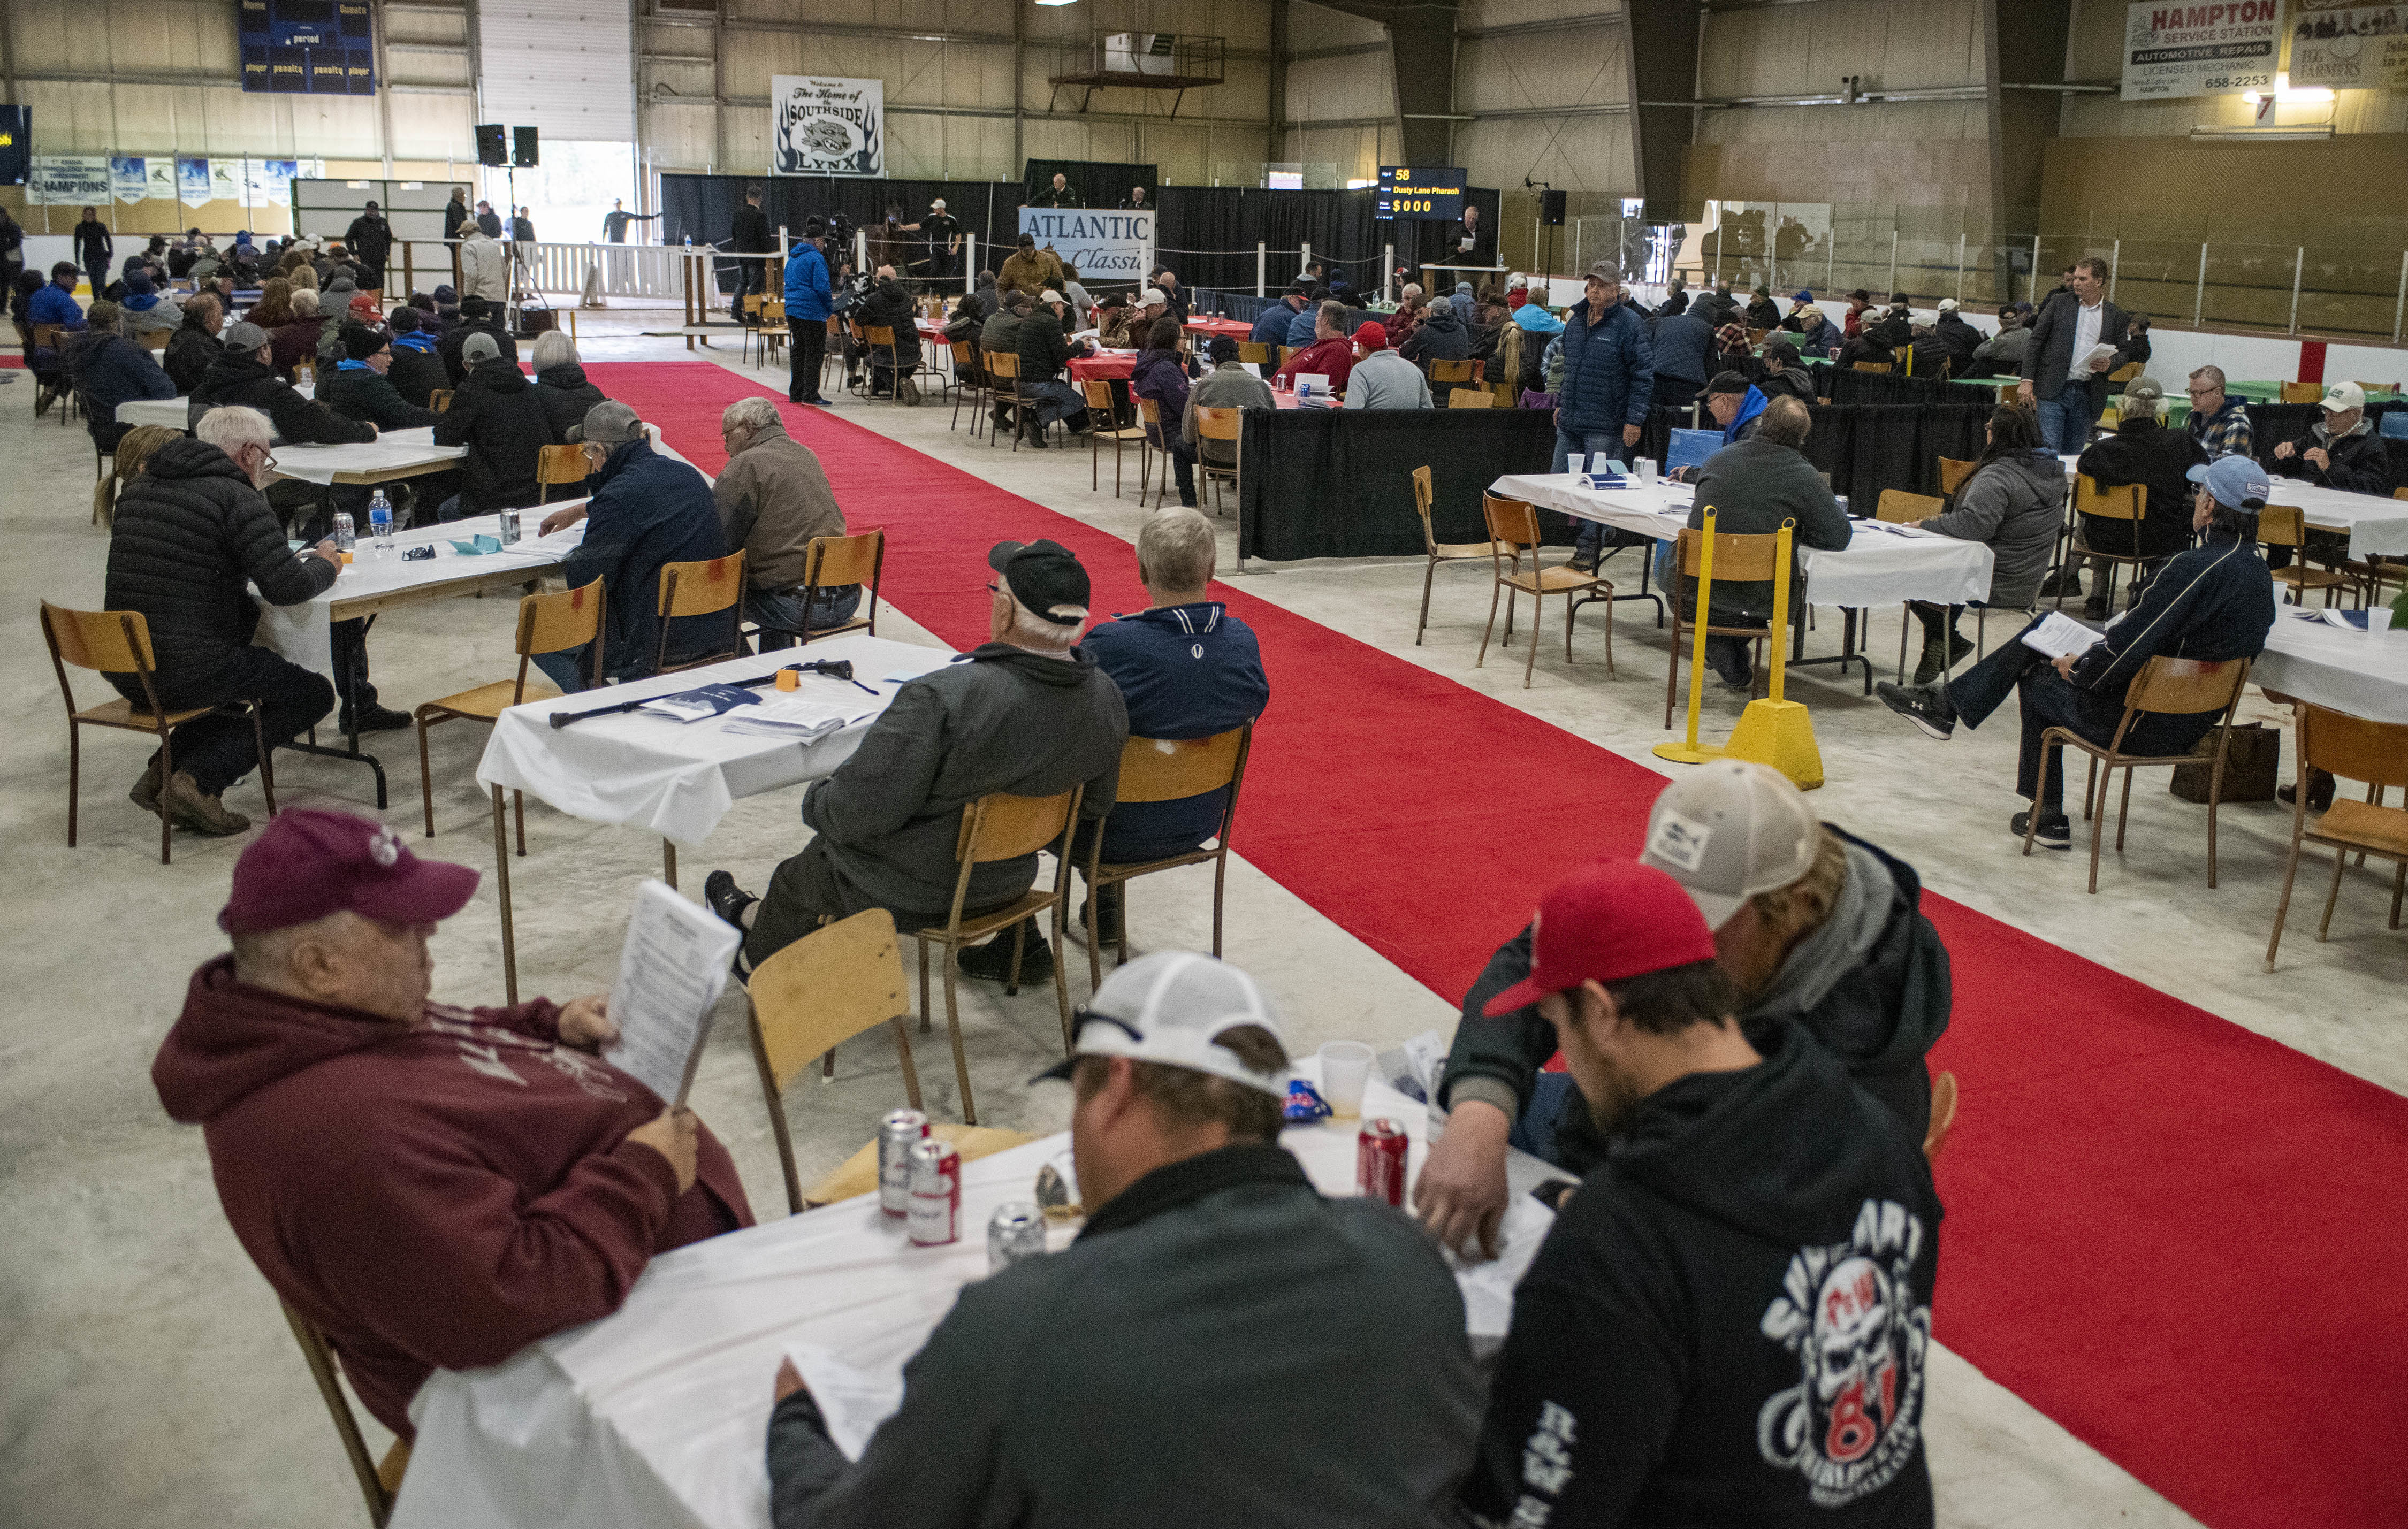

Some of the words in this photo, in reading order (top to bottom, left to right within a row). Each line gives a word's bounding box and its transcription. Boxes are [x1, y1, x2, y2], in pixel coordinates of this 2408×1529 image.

[2152, 0, 2276, 30] HAMPTON
[294, 34, 320, 43] period
[2163, 29, 2217, 44] SERVICE
[2220, 25, 2273, 40] STATION
[2136, 48, 2213, 62] AUTOMOTIVE
[2220, 44, 2265, 55] REPAIR
[246, 63, 267, 73] player
[273, 64, 303, 75] penalty
[314, 65, 344, 76] penalty
[348, 66, 370, 76] player
[2143, 64, 2196, 76] LICENSED
[2197, 60, 2255, 72] MECHANIC
[2205, 75, 2268, 88] 658-2253
[793, 88, 813, 99] The
[816, 88, 848, 100] Home
[849, 90, 863, 103] of
[2258, 97, 2274, 120] 7
[790, 105, 863, 131] SOUTHSIDE
[796, 149, 858, 170] LYNX
[1395, 168, 1410, 181] 58
[32, 180, 108, 193] CHAMPIONS
[1393, 186, 1414, 195] Dusty
[1414, 186, 1431, 194] Lane
[1431, 187, 1460, 195] Pharaoh
[1027, 215, 1148, 240] ATLANTIC
[1072, 248, 1149, 270] Classi
